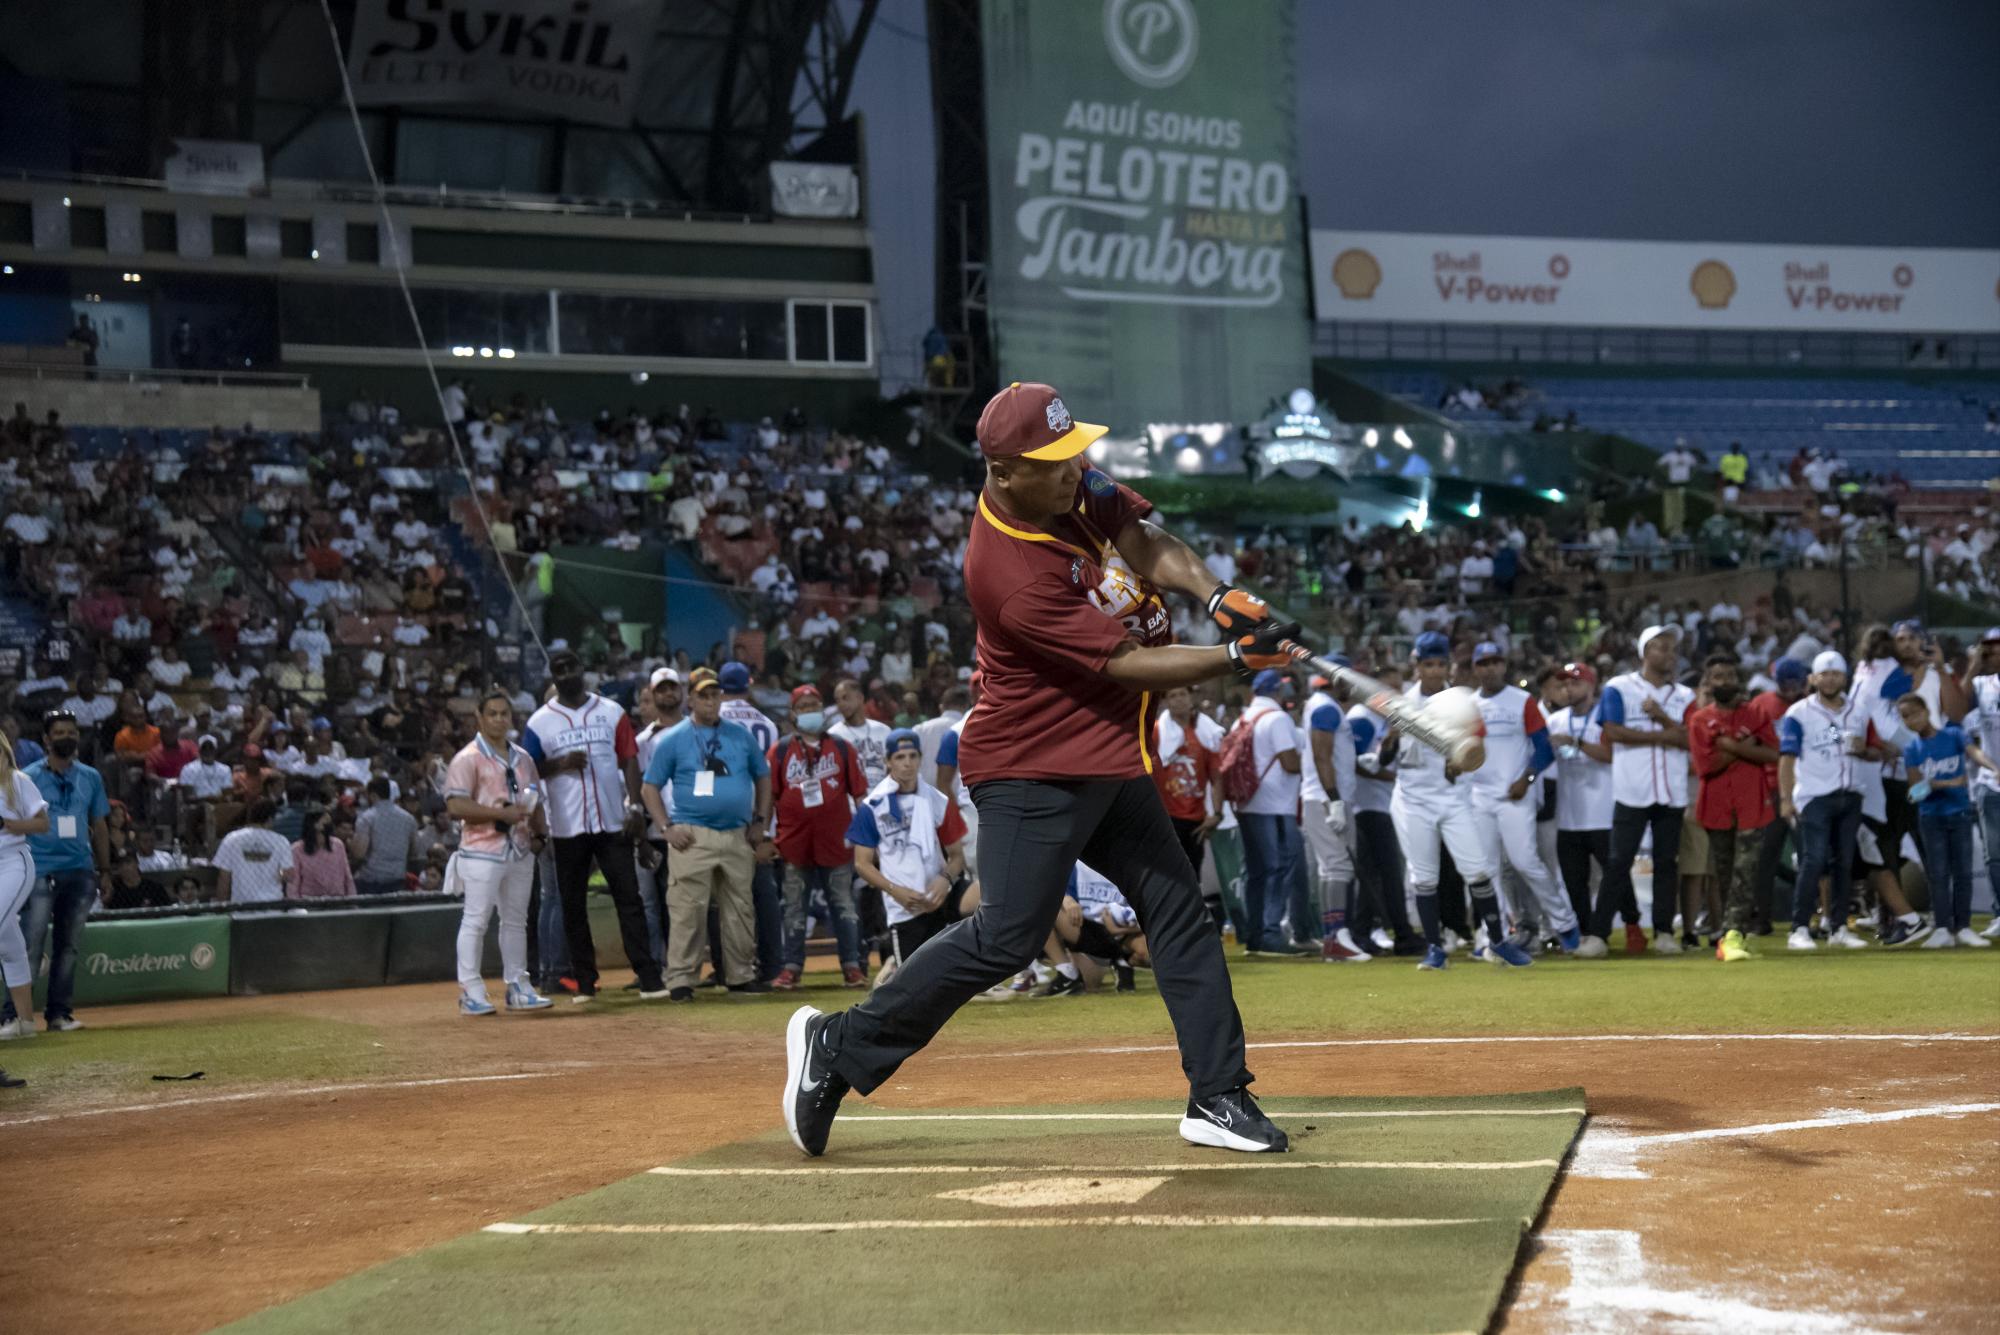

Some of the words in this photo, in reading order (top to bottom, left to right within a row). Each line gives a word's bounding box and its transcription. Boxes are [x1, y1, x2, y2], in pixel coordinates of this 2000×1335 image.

[361, 60, 478, 84] ELITE
[508, 65, 622, 104] VODKA
[1063, 97, 1141, 137] AQUÍ
[1143, 109, 1242, 149] SOMOS
[1015, 133, 1289, 215] PELOTERO
[1185, 212, 1254, 239] HASTA
[1259, 220, 1286, 241] LA
[1016, 197, 1284, 307] Tambora
[1433, 250, 1481, 272] Shell
[1784, 261, 1830, 281] Shell
[1434, 275, 1559, 304] V-Power
[1786, 285, 1904, 313] V-Power
[86, 952, 186, 975] Presidente
